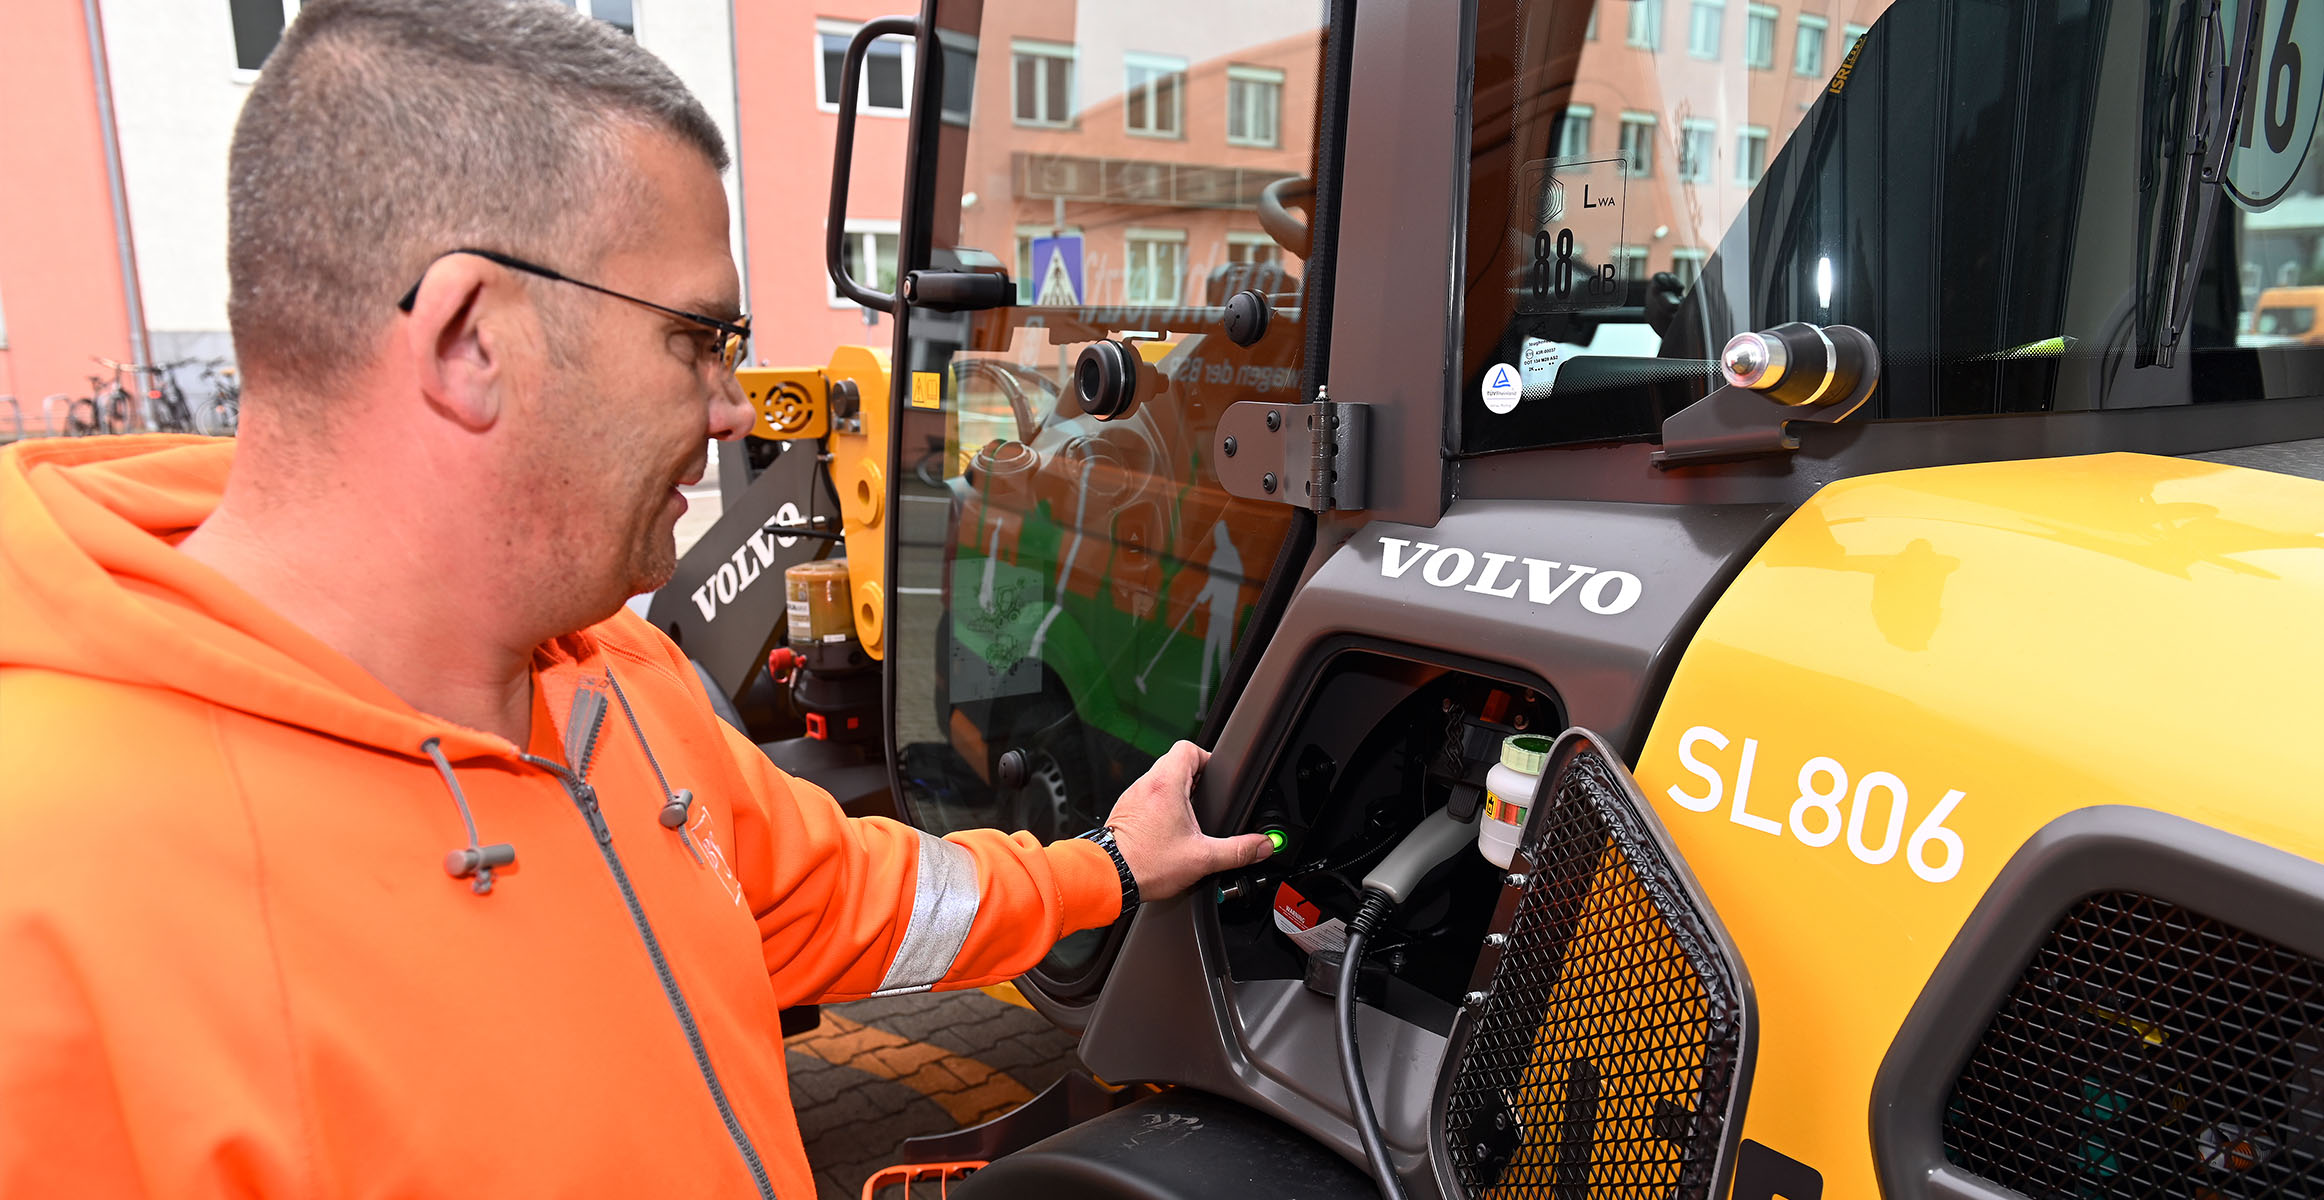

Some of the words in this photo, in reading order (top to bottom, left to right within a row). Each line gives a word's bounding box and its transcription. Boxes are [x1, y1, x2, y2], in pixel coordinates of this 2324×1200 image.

[1532, 228, 1574, 301] 88
[1588, 263, 1617, 297] dB
[691, 502, 800, 623] VOLVO
[1378, 536, 1642, 615] VOLVO
[1666, 725, 1967, 883] SL806
